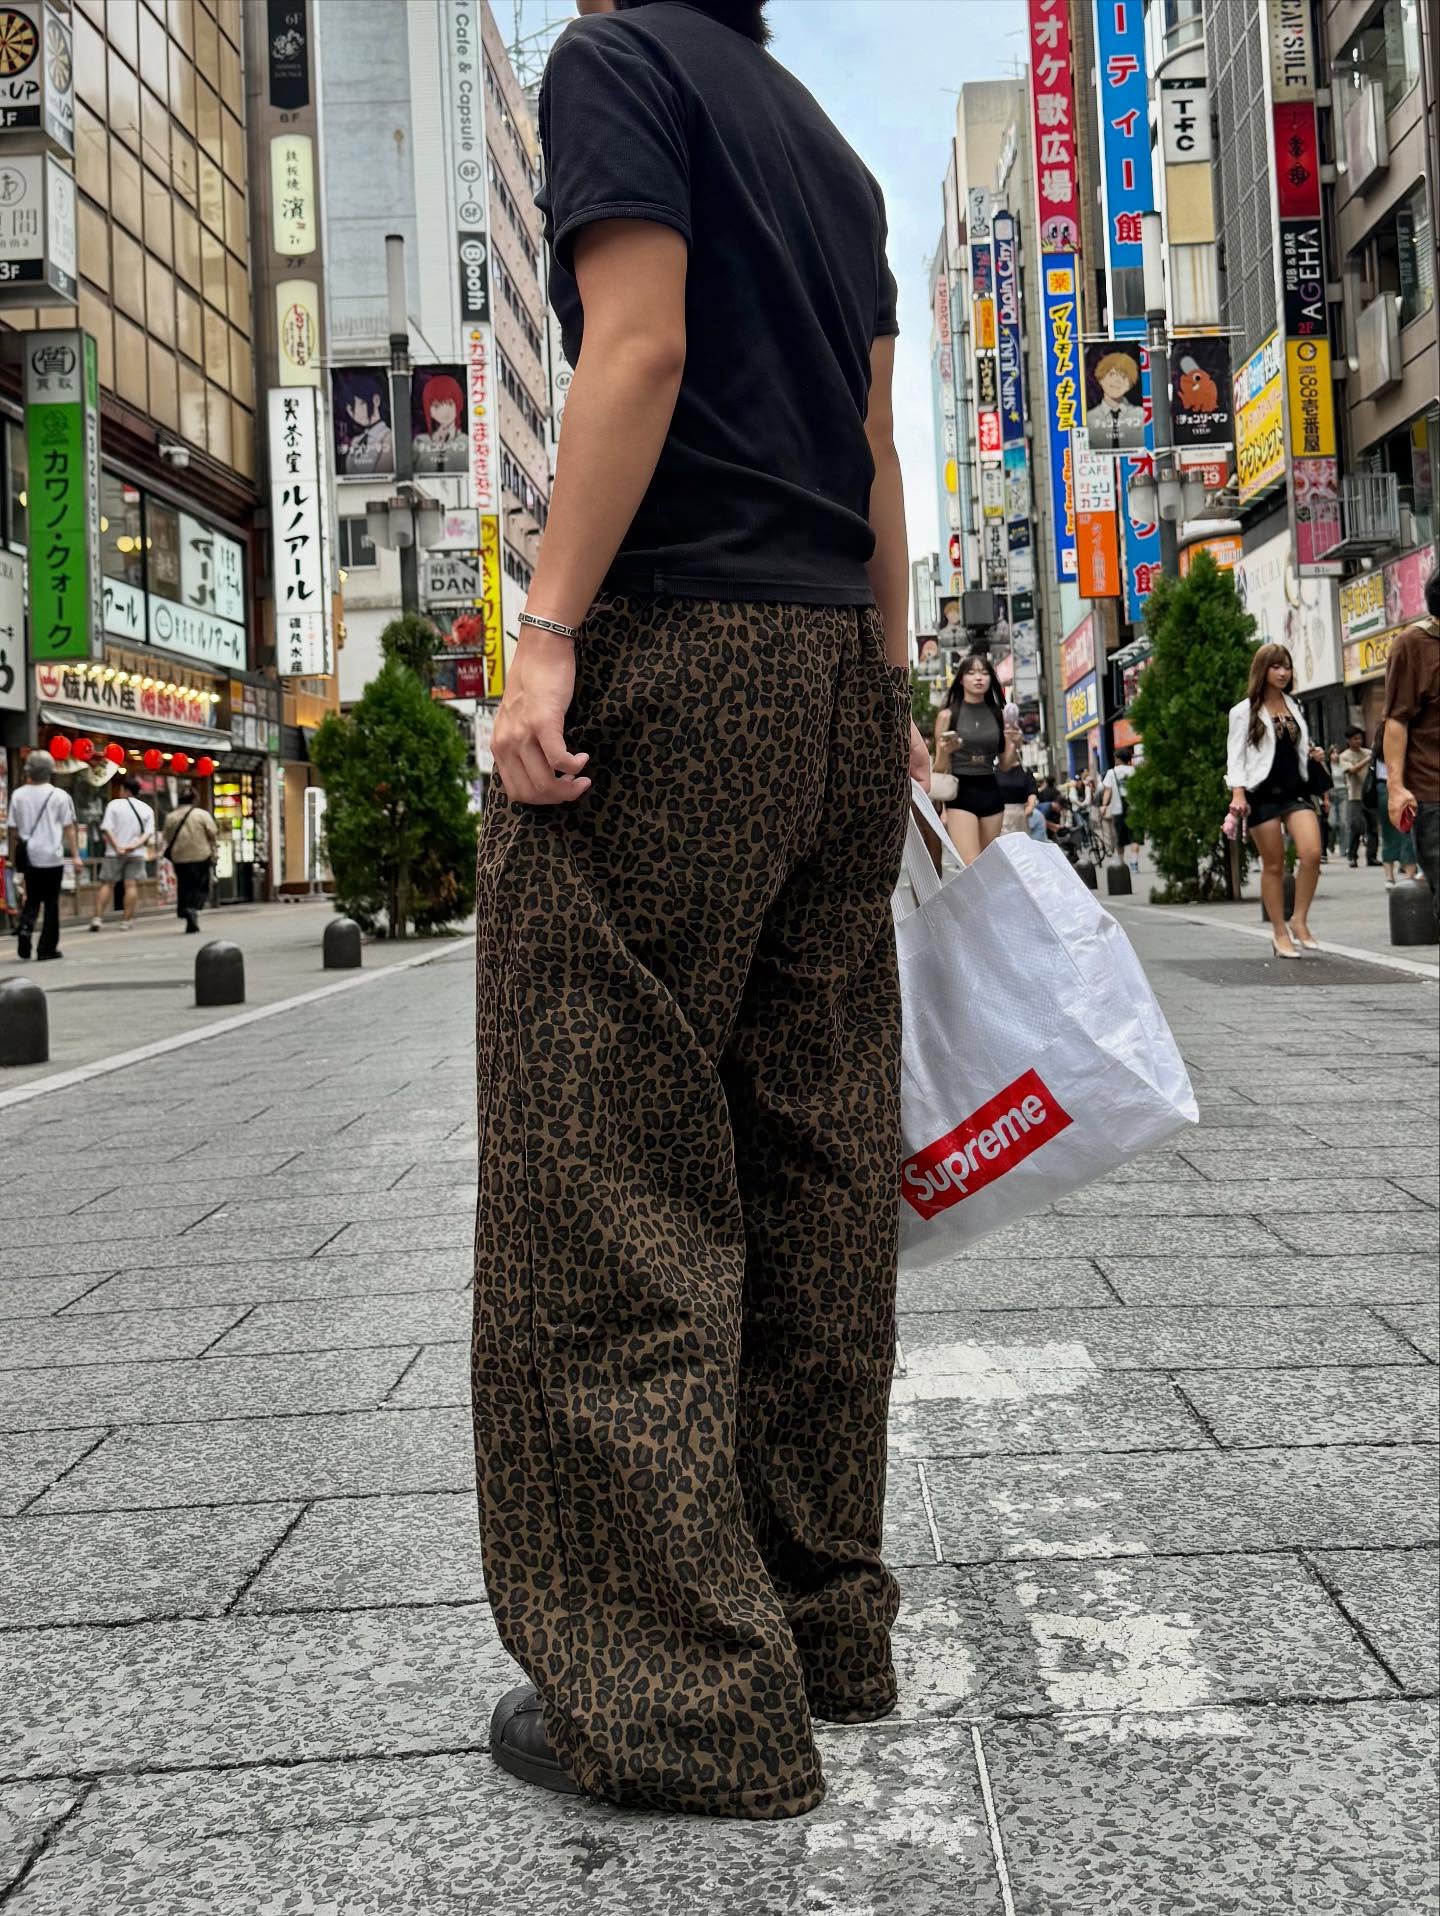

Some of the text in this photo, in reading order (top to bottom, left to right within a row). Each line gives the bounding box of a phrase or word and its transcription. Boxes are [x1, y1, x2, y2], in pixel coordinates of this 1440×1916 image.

[456, 14, 470, 55] Cafe
[459, 62, 472, 73] &
[457, 80, 475, 152] Capsule
[1034, 0, 1073, 204] オケ歌広場
[1172, 100, 1195, 151] TFC
[1284, 233, 1296, 254] BAR
[460, 240, 486, 310] Booth
[1286, 269, 1298, 291] PUB
[1298, 228, 1323, 320] AGEHA
[1297, 321, 1314, 334] 2F
[38, 346, 69, 374] 質
[469, 342, 486, 404] カラオケ
[1079, 465, 1109, 477] CAFE
[45, 448, 72, 650] カワノ・クォーク
[282, 485, 313, 601] ルノアール
[431, 576, 476, 595] DAN
[904, 1094, 1047, 1201] Supreme
